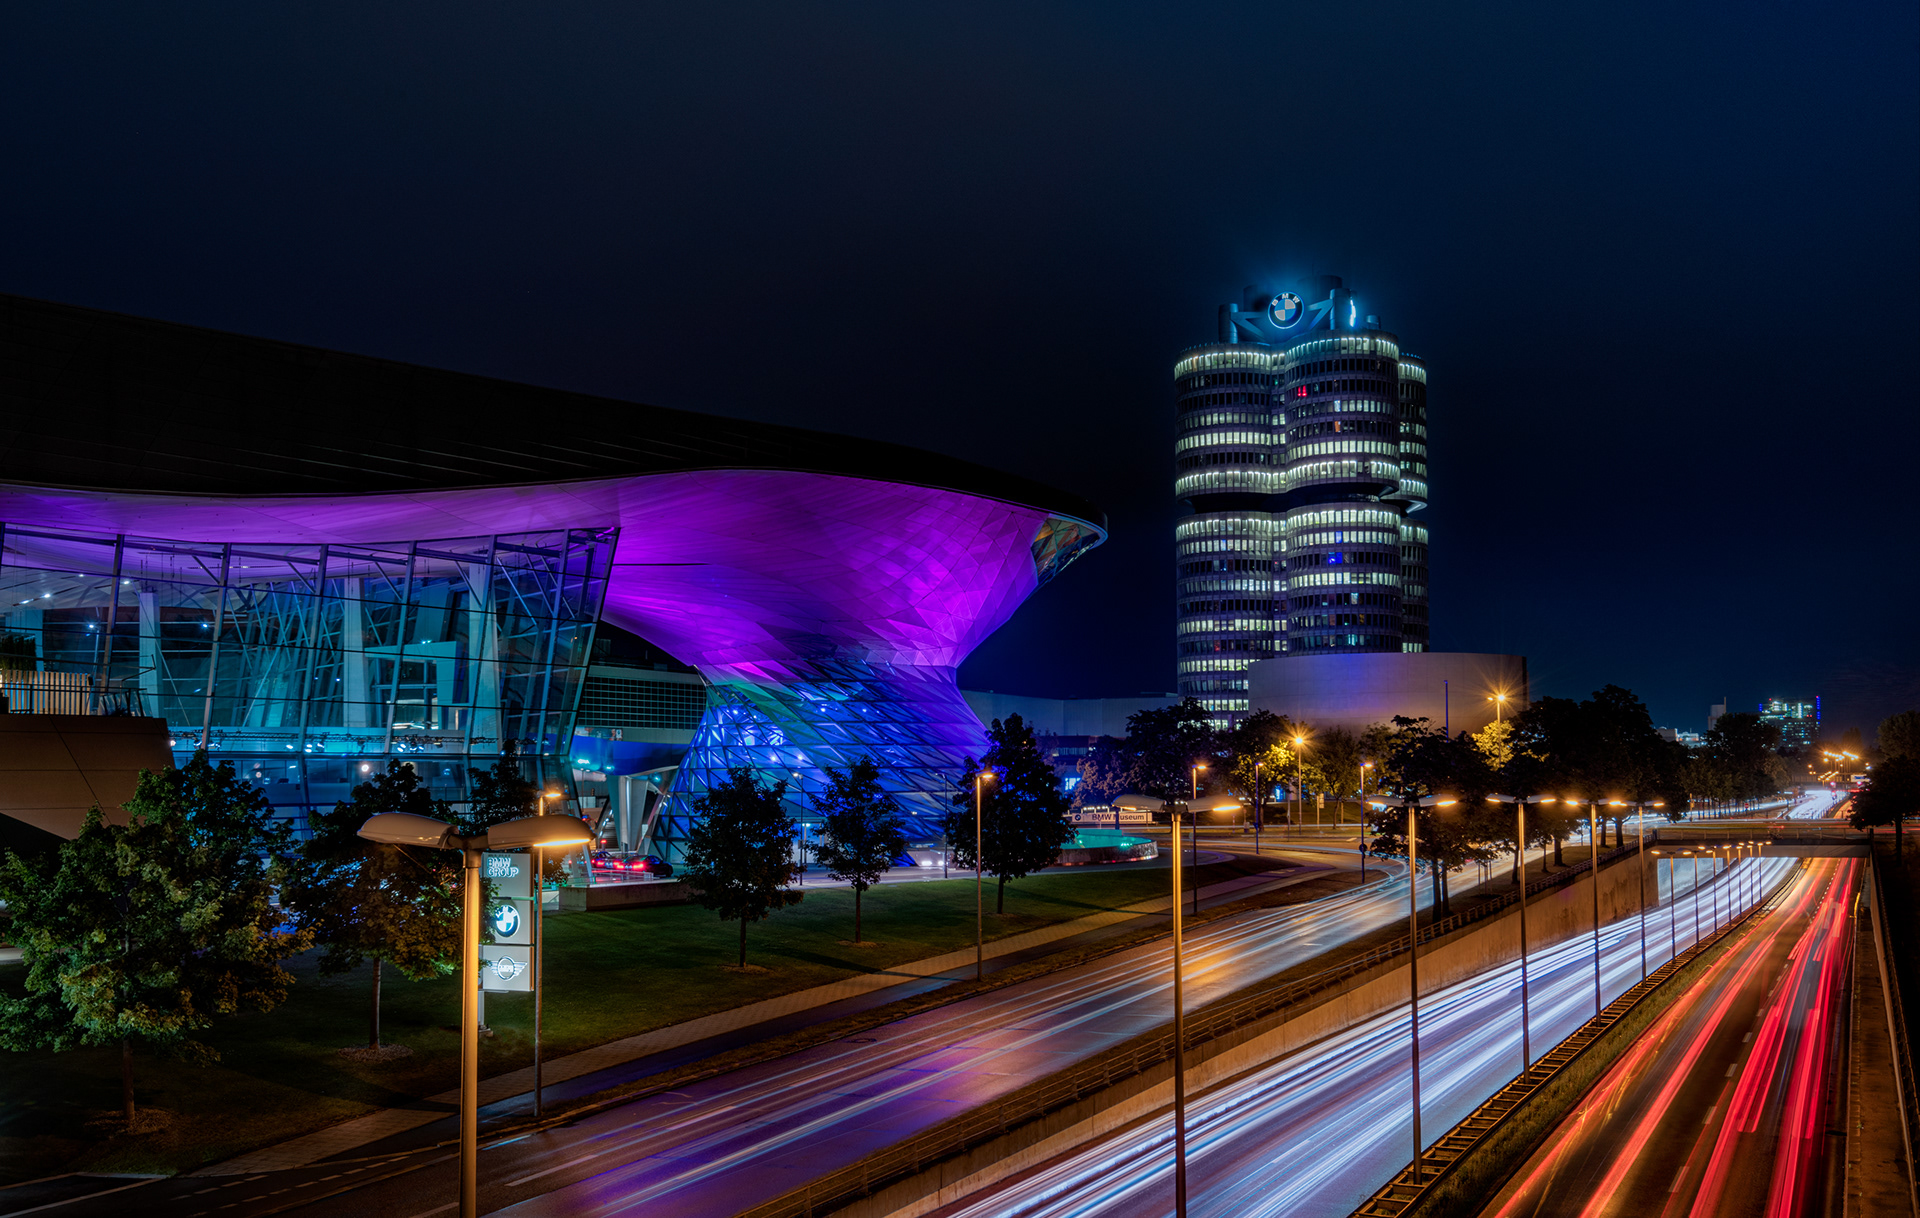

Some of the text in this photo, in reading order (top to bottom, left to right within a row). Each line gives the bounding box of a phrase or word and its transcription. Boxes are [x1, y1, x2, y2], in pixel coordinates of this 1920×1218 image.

[1272, 293, 1300, 306] BMW
[487, 857, 511, 867] BMW
[487, 867, 520, 878] GROUP
